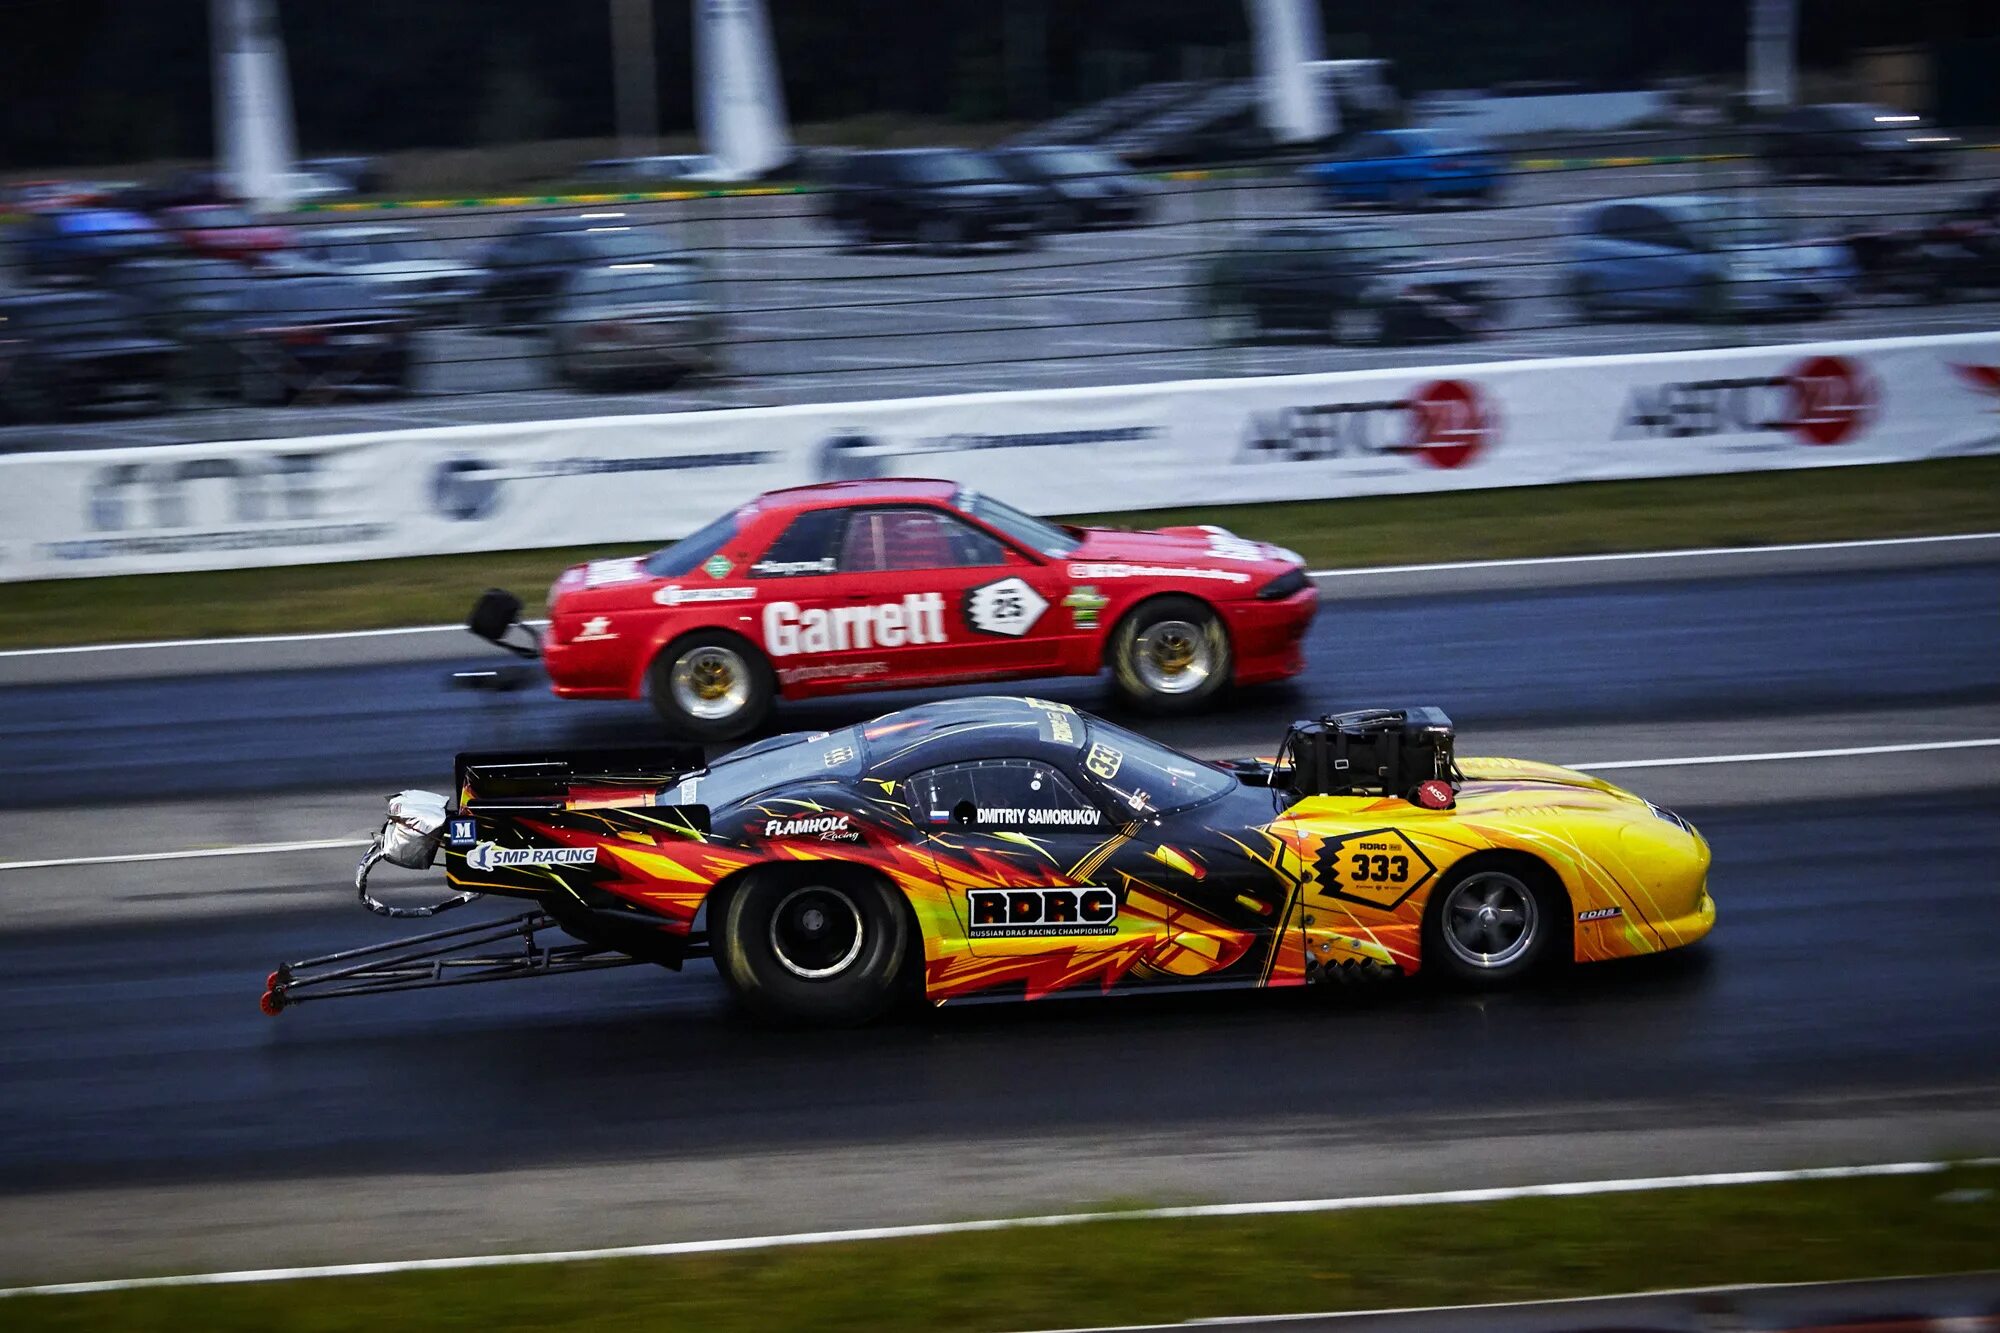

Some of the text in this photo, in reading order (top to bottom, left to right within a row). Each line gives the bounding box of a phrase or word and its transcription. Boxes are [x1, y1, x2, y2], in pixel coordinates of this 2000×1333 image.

[992, 597, 1022, 618] 25
[763, 592, 948, 656] Garrett
[1427, 785, 1447, 801] MSD
[977, 808, 1101, 825] DMITRIY SAMORUKOV
[454, 822, 471, 838] M
[765, 816, 849, 836] FLAMHOLC
[819, 831, 859, 841] Racing
[493, 849, 595, 864] SMP RACING
[1351, 854, 1409, 882] 333
[969, 888, 1115, 926] RDRC
[970, 927, 1117, 937] RUSSIAN DRAG RACING CHAMPIONSHIP
